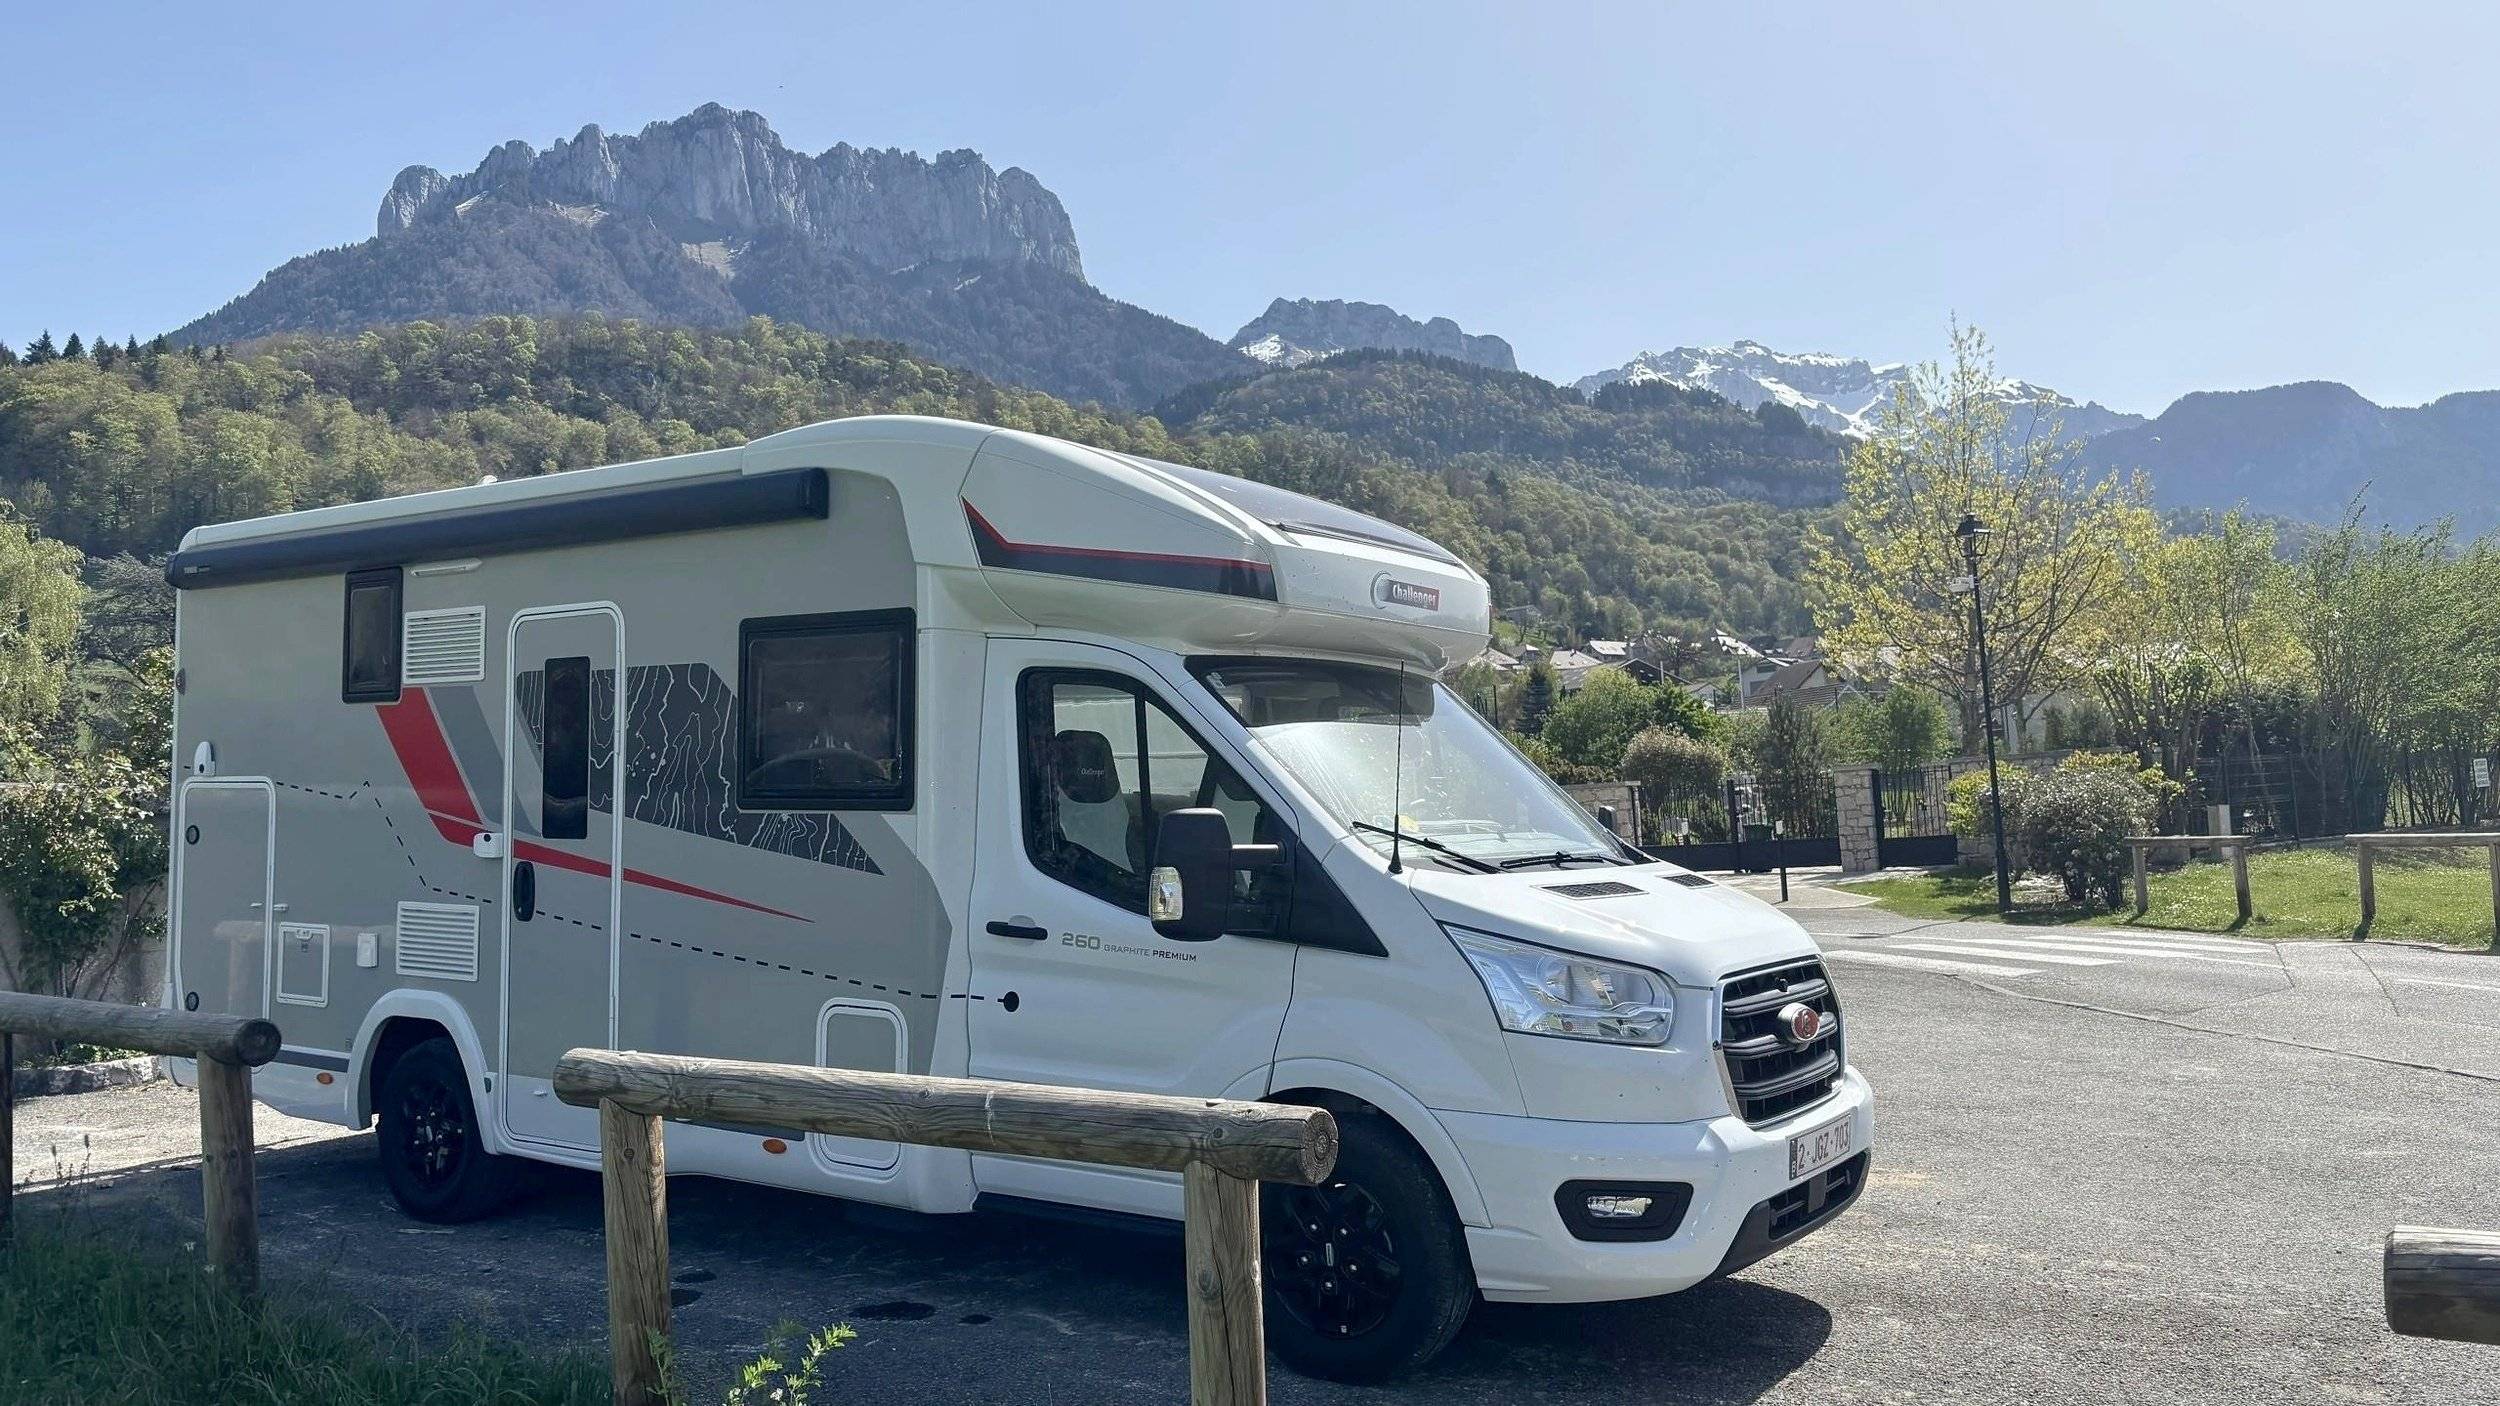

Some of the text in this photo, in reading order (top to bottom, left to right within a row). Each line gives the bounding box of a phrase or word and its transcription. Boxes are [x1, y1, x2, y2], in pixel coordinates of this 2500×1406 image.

[1392, 582, 1437, 607] Challenger
[1061, 932, 1197, 962] 260 GRAPHITE PREMIUM
